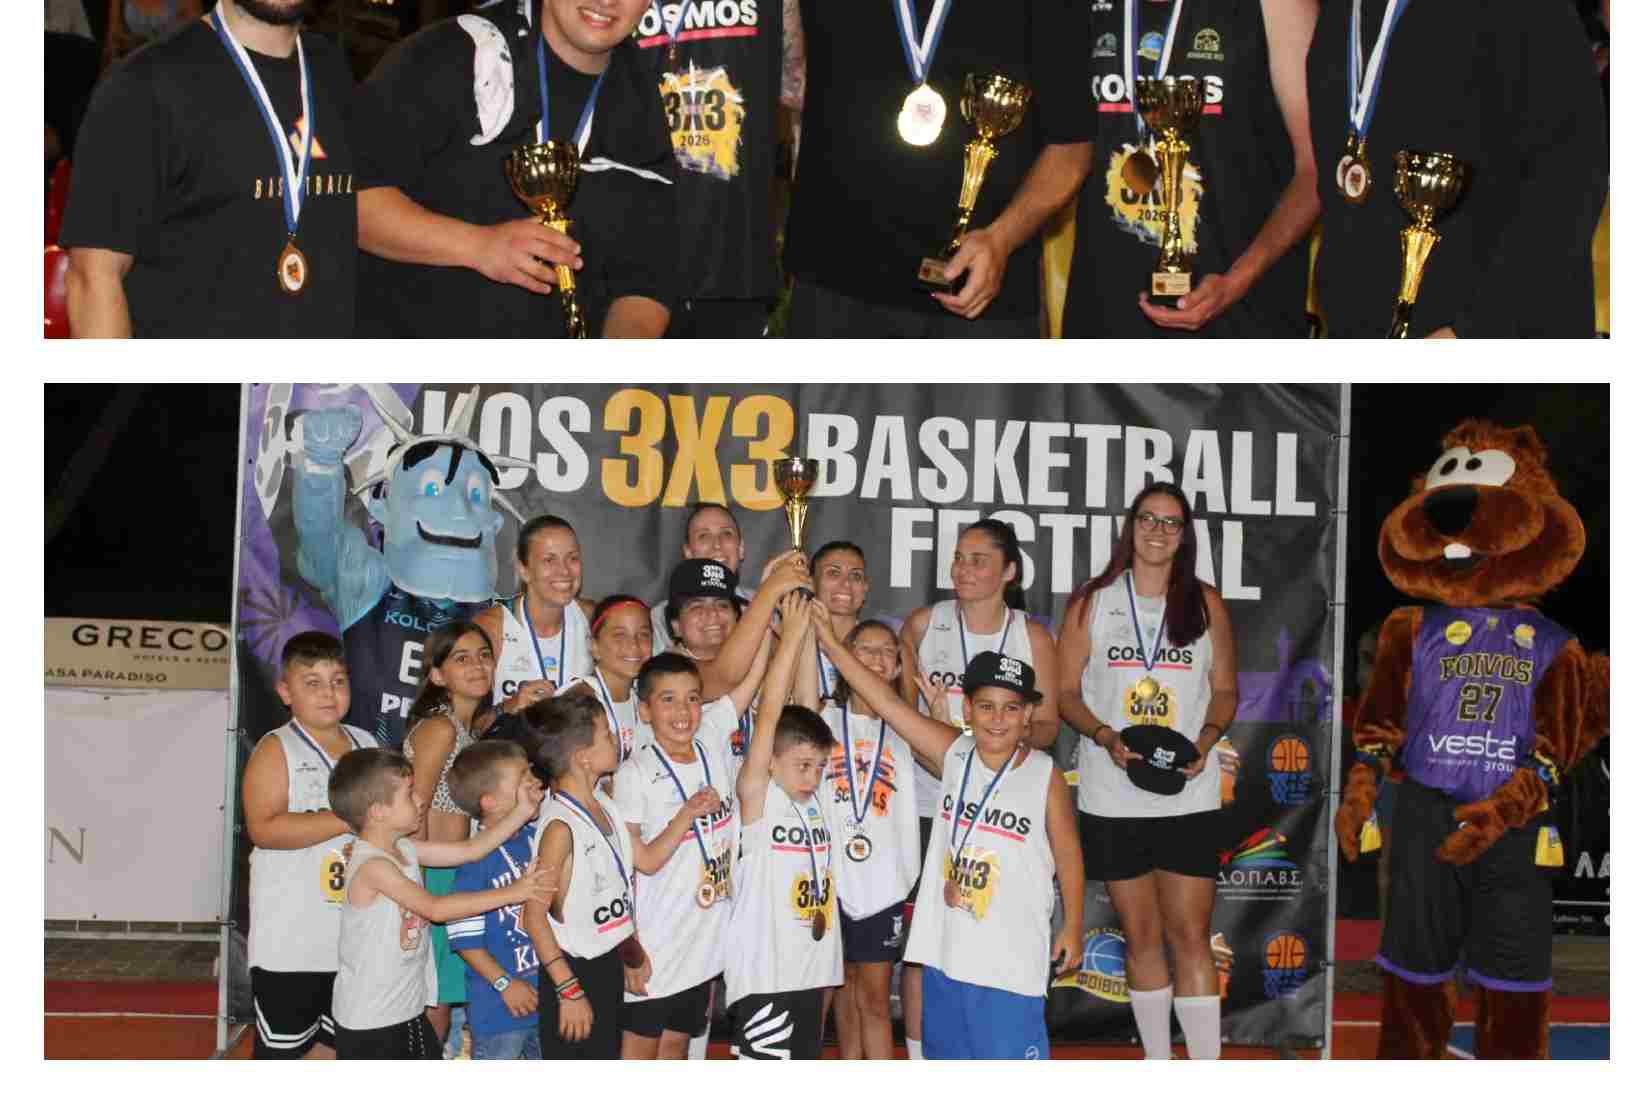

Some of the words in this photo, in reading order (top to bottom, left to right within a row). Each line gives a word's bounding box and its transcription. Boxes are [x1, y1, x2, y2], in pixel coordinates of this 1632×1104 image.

[601, 387, 796, 510] 3X3
[806, 412, 1317, 517] BASKETBALL
[72, 624, 229, 652] GRECO
[81, 669, 167, 683] PARADISO
[1440, 652, 1534, 685] FOIVOS
[1457, 682, 1504, 722] 27
